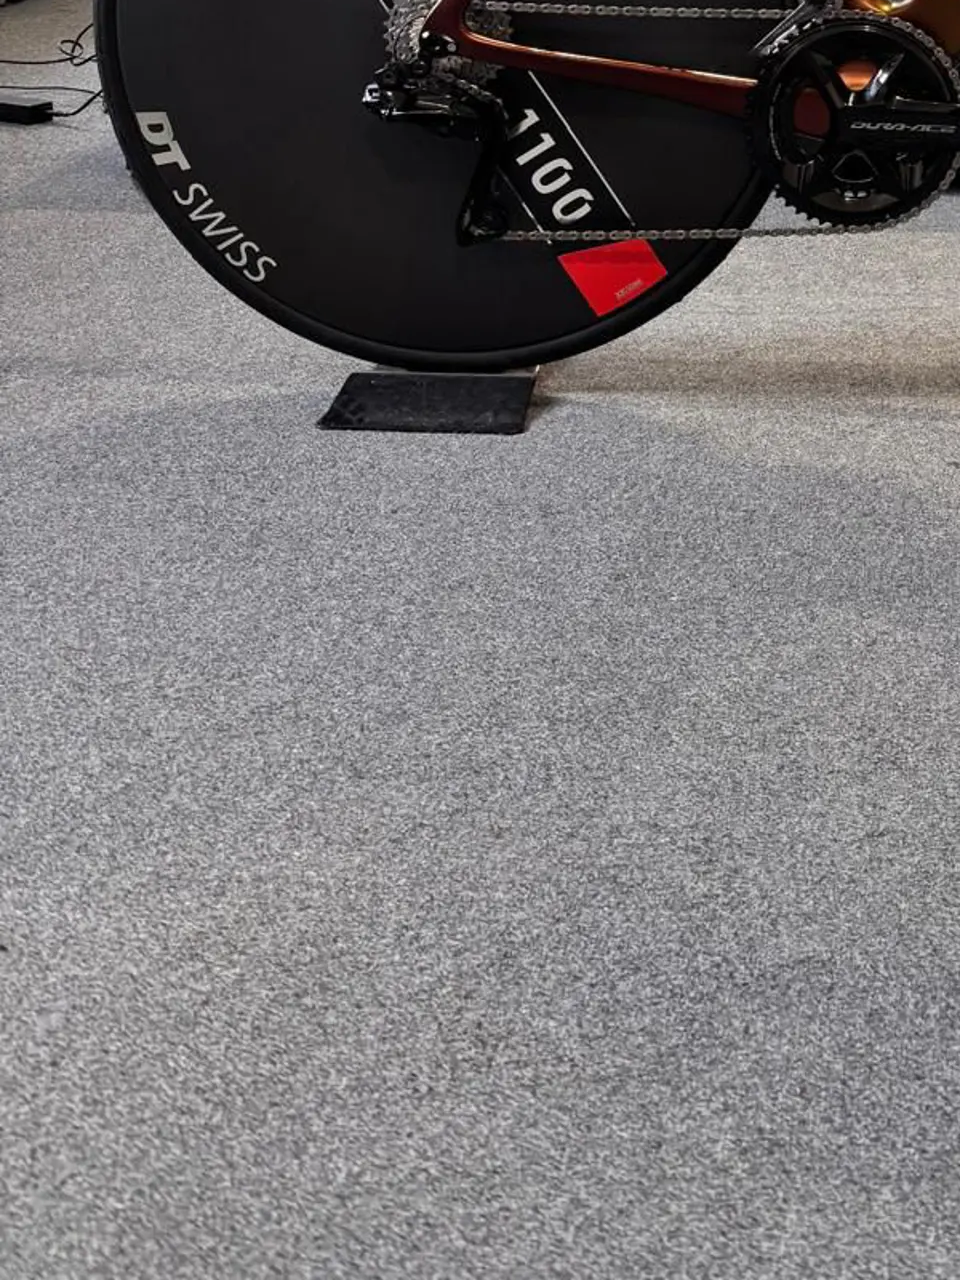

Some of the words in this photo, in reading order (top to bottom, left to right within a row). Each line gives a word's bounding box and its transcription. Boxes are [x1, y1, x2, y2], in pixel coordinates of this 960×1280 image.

[509, 108, 595, 225] 1100
[850, 121, 957, 133] DURA-ACE
[135, 111, 191, 171] DT
[172, 183, 278, 283] SWISS
